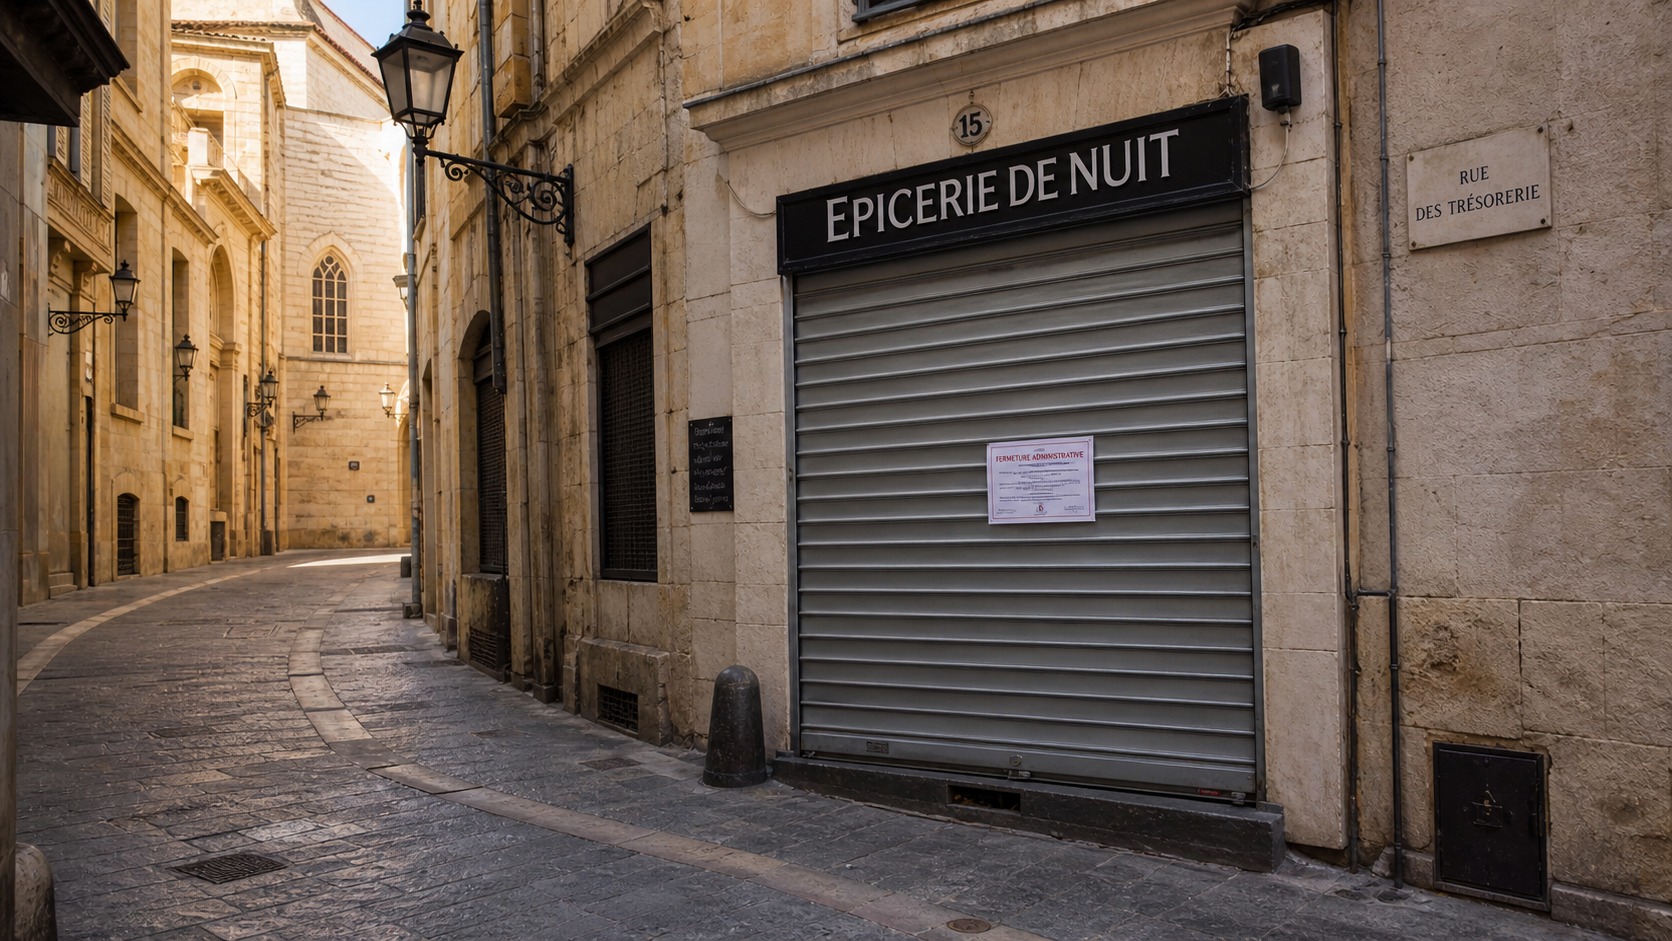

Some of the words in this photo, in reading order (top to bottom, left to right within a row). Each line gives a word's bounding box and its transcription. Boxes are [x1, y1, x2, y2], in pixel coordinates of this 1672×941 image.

[959, 111, 982, 138] 15
[826, 170, 998, 242] EPICERIE
[1008, 157, 1058, 207] DE
[1069, 128, 1179, 195] NUIT
[1460, 166, 1489, 185] RUE
[1416, 204, 1442, 221] DES
[1448, 184, 1541, 215] TRÉSORERIE
[996, 454, 1031, 463] FERMETURE
